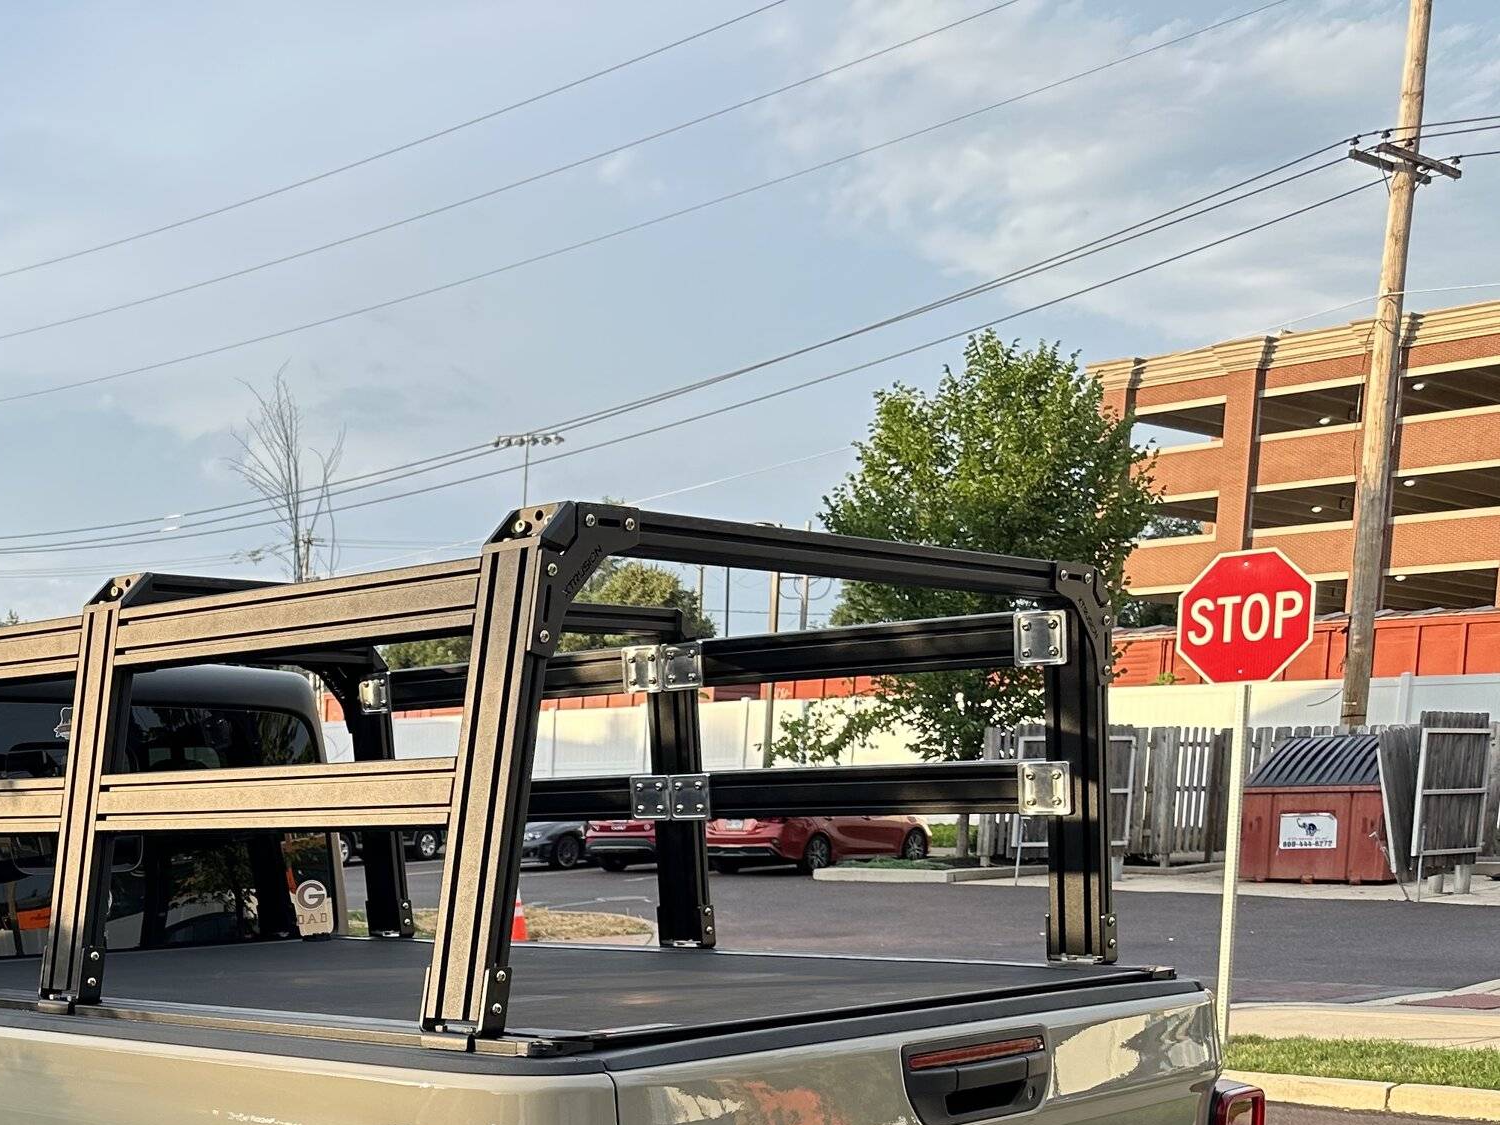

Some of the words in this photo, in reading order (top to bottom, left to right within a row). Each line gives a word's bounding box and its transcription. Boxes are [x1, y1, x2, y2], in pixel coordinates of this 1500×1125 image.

[562, 545, 603, 597] XTRUSION
[1187, 590, 1304, 646] STOP
[297, 882, 326, 909] G
